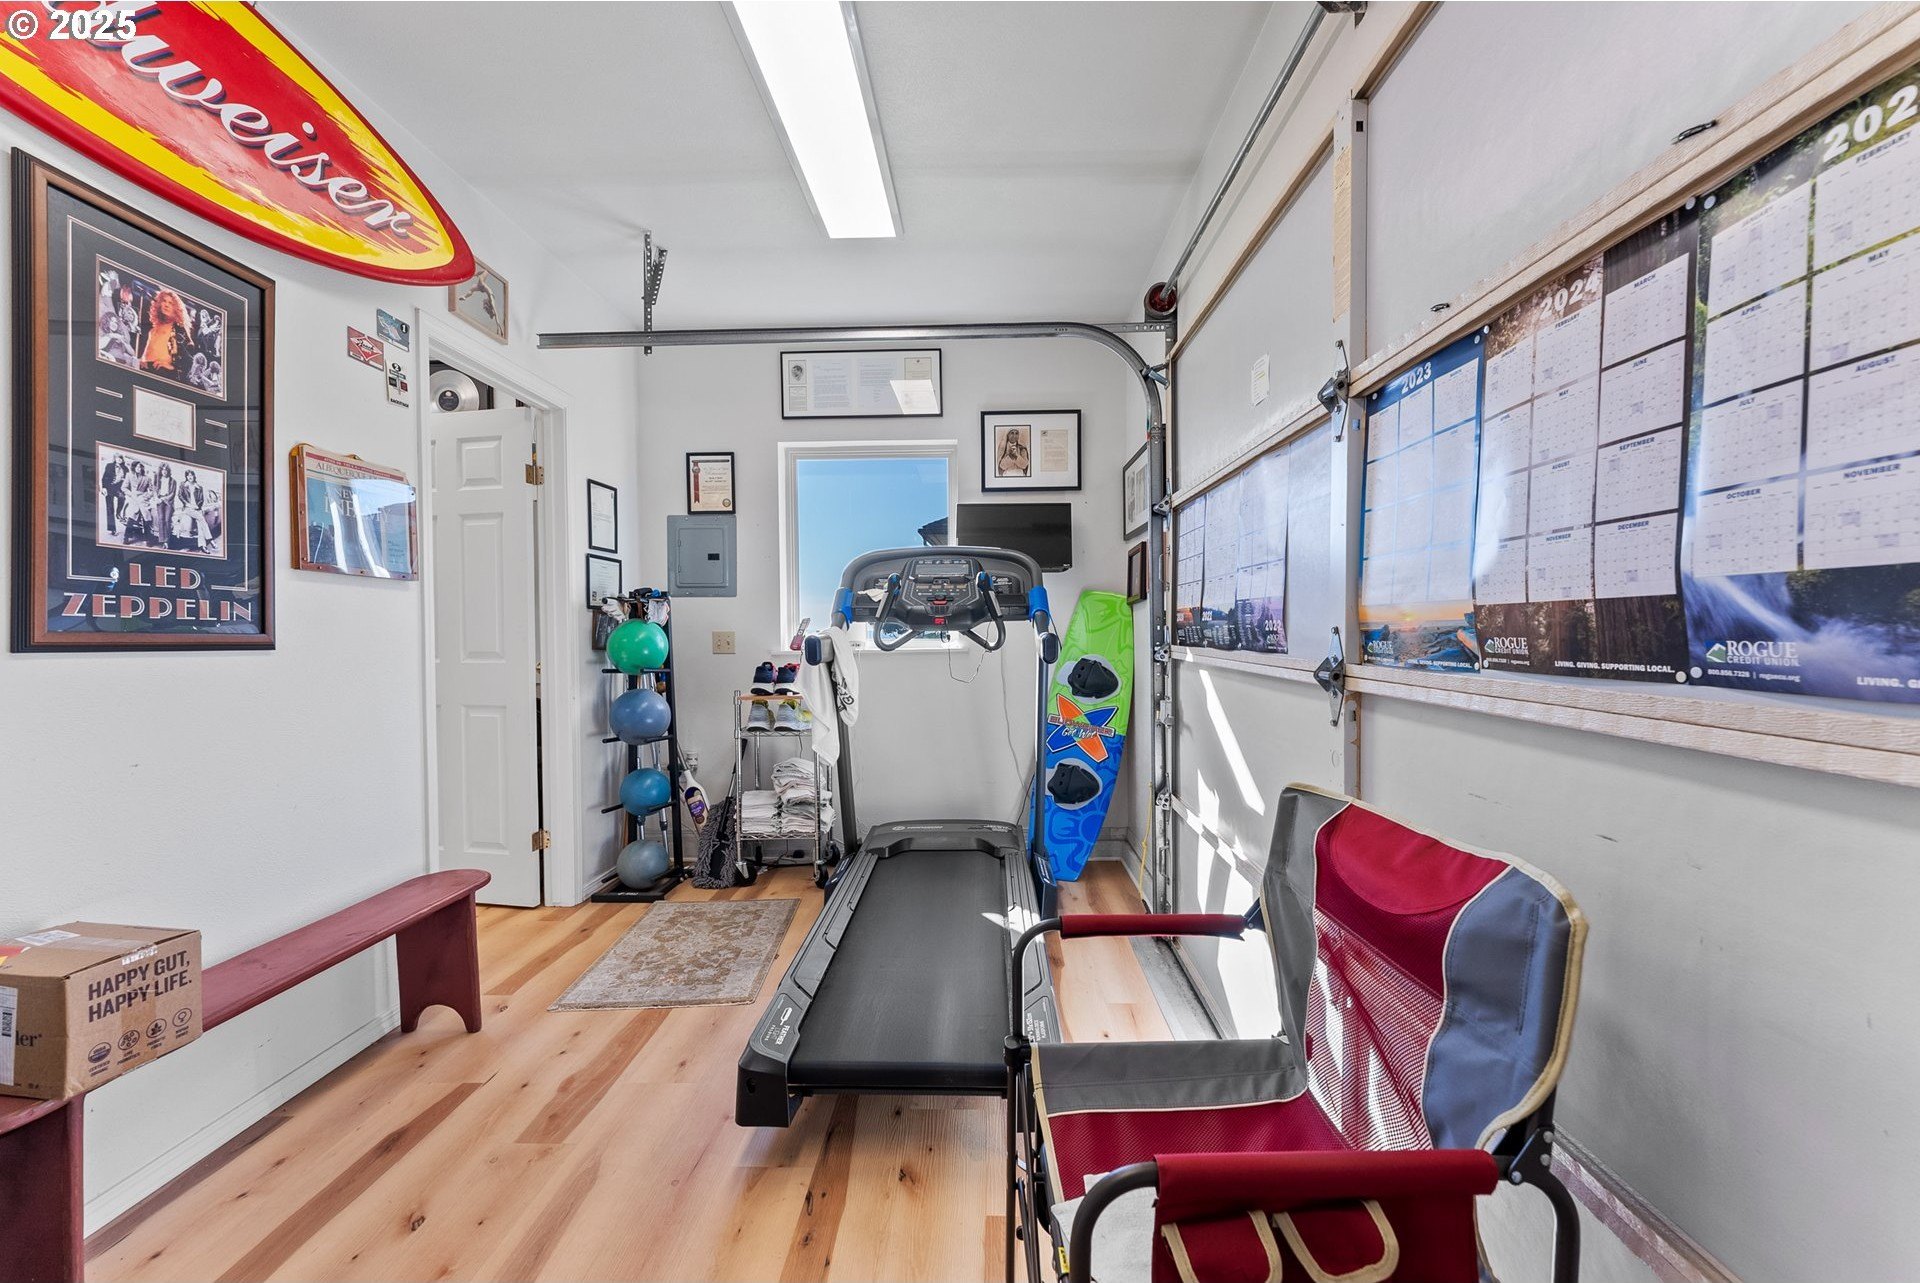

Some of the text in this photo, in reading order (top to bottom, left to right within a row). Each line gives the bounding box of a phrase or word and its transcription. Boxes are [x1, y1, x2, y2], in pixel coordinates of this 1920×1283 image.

[1855, 131, 1911, 163] FEBRUARY
[1867, 249, 1890, 263] MAY
[1633, 273, 1657, 288] MARCH
[1539, 268, 1601, 320] 2024
[1741, 303, 1762, 316] APRIL
[1555, 313, 1580, 329] FEBRUARY
[1632, 357, 1648, 368] JUNE
[1855, 354, 1896, 373] AUGUST
[1401, 361, 1432, 394] 2023
[1558, 389, 1569, 398] MAY
[1619, 437, 1655, 451] SEPTEMBER
[1551, 460, 1570, 470] AUGUST
[1843, 463, 1901, 479] NOVEMBER
[1726, 488, 1761, 499] OCTOBER
[1617, 520, 1650, 531] DECEMBER
[1546, 533, 1571, 542] NOVEMBER
[129, 563, 201, 589] LED
[62, 592, 252, 622] ZEPPELIN
[1493, 637, 1529, 650] ROGUE
[1726, 640, 1799, 659] ROGUE
[1554, 660, 1576, 668] LIVING.
[1601, 663, 1645, 672] SUPPORTING
[1646, 665, 1676, 674] LOCAL.
[1727, 656, 1800, 667] CREDIT UNION
[1856, 676, 1904, 688] LIVING.
[88, 950, 191, 1001] HAPPY GUT,
[88, 969, 192, 1023] HAPPY LIFE.
